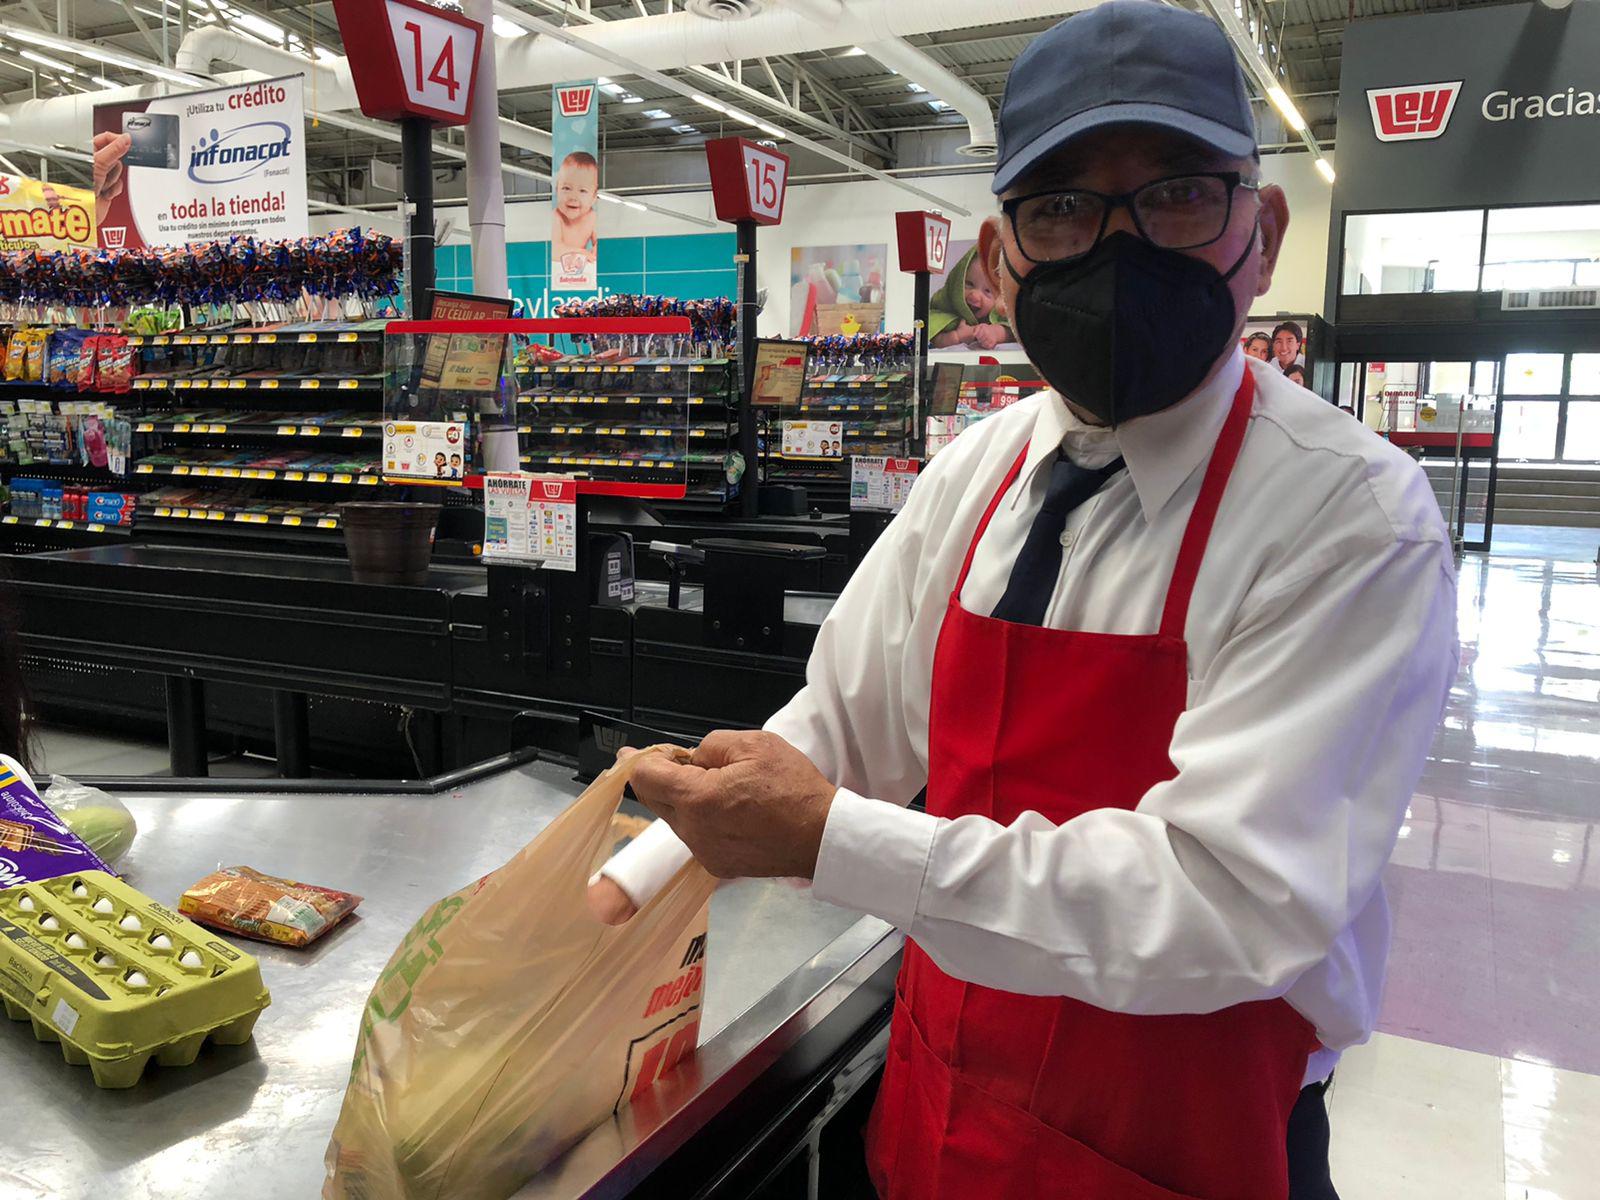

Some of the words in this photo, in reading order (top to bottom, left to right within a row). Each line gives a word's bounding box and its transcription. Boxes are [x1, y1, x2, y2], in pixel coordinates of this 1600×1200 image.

[404, 21, 461, 102] 14
[186, 103, 214, 118] ¡Utiliza
[216, 103, 225, 112] tu
[228, 84, 286, 110] crédito
[190, 138, 292, 168] infonacot
[264, 167, 290, 178] (Fonacot)
[751, 158, 777, 209] 15
[157, 213, 168, 221] en
[170, 198, 208, 220] toda
[211, 197, 226, 217] la
[229, 191, 286, 216] tienda!
[158, 224, 170, 232] Usa
[178, 222, 198, 231] crédito
[231, 219, 239, 227] de
[240, 218, 260, 229] compra
[269, 215, 286, 223] todos
[188, 231, 212, 239] nuestros
[929, 225, 943, 263] 16
[434, 306, 447, 319] TU
[447, 308, 486, 321] CELULAR
[0, 790, 33, 819] Chocolate
